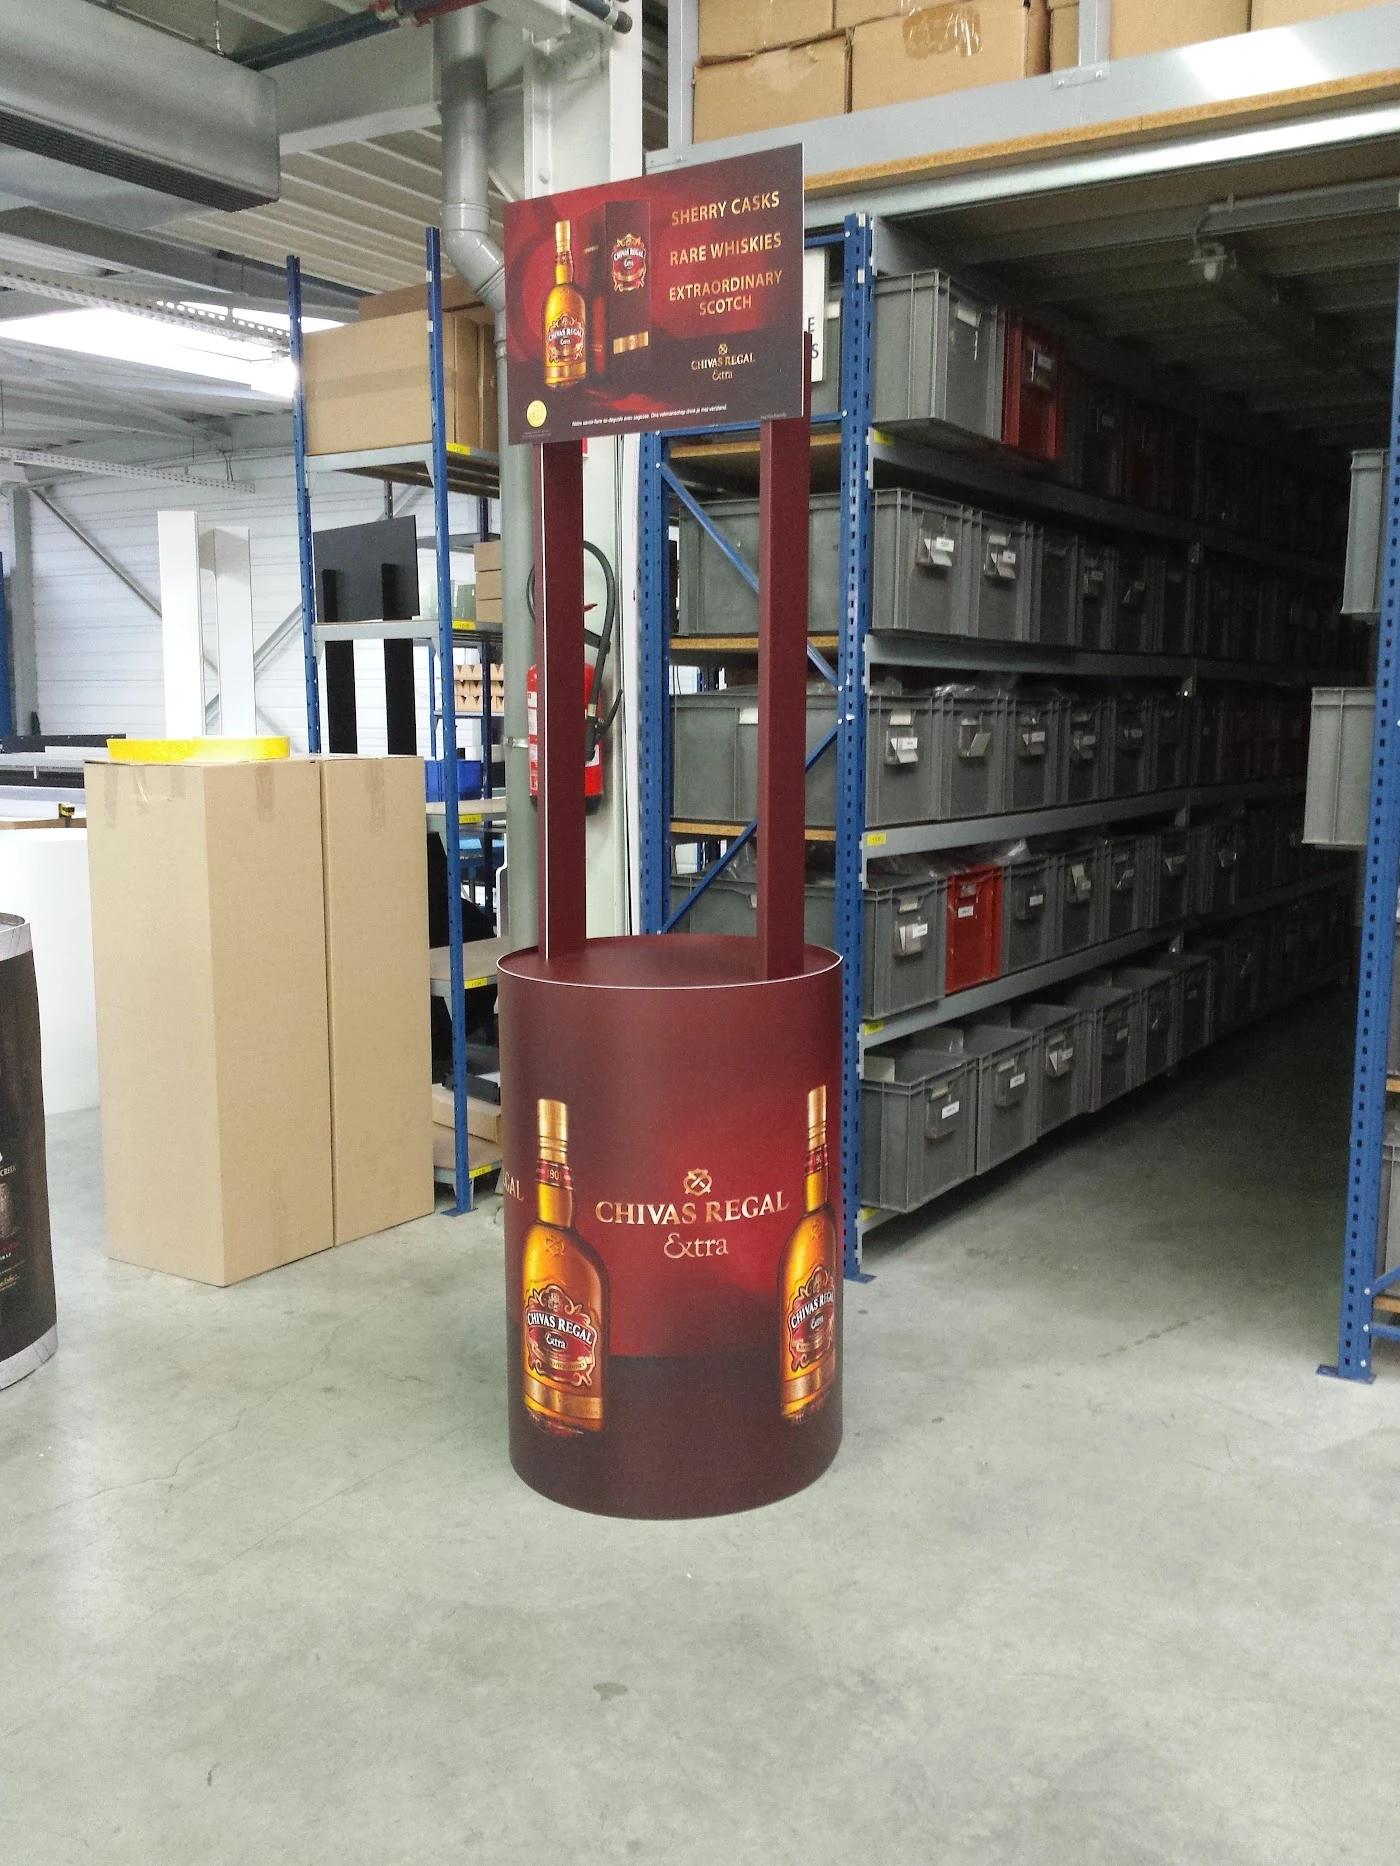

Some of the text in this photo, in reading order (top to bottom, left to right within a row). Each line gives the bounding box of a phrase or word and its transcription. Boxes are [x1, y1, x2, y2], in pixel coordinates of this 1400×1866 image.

[671, 191, 780, 226] SHERRY CASKS
[670, 232, 782, 266] RARE WHISKIES
[669, 270, 783, 302] EXTRAORDINARY
[699, 295, 752, 316] SCOTCH
[691, 353, 755, 371] CHIVAS REGAL
[712, 370, 733, 381] Extra
[595, 1191, 790, 1225] CHIVAS REGAL
[664, 1232, 729, 1259] Extra
[527, 1312, 593, 1345] CHIVAS REGAL
[791, 1298, 819, 1329] CHIVAS
[546, 1332, 566, 1349] Extra
